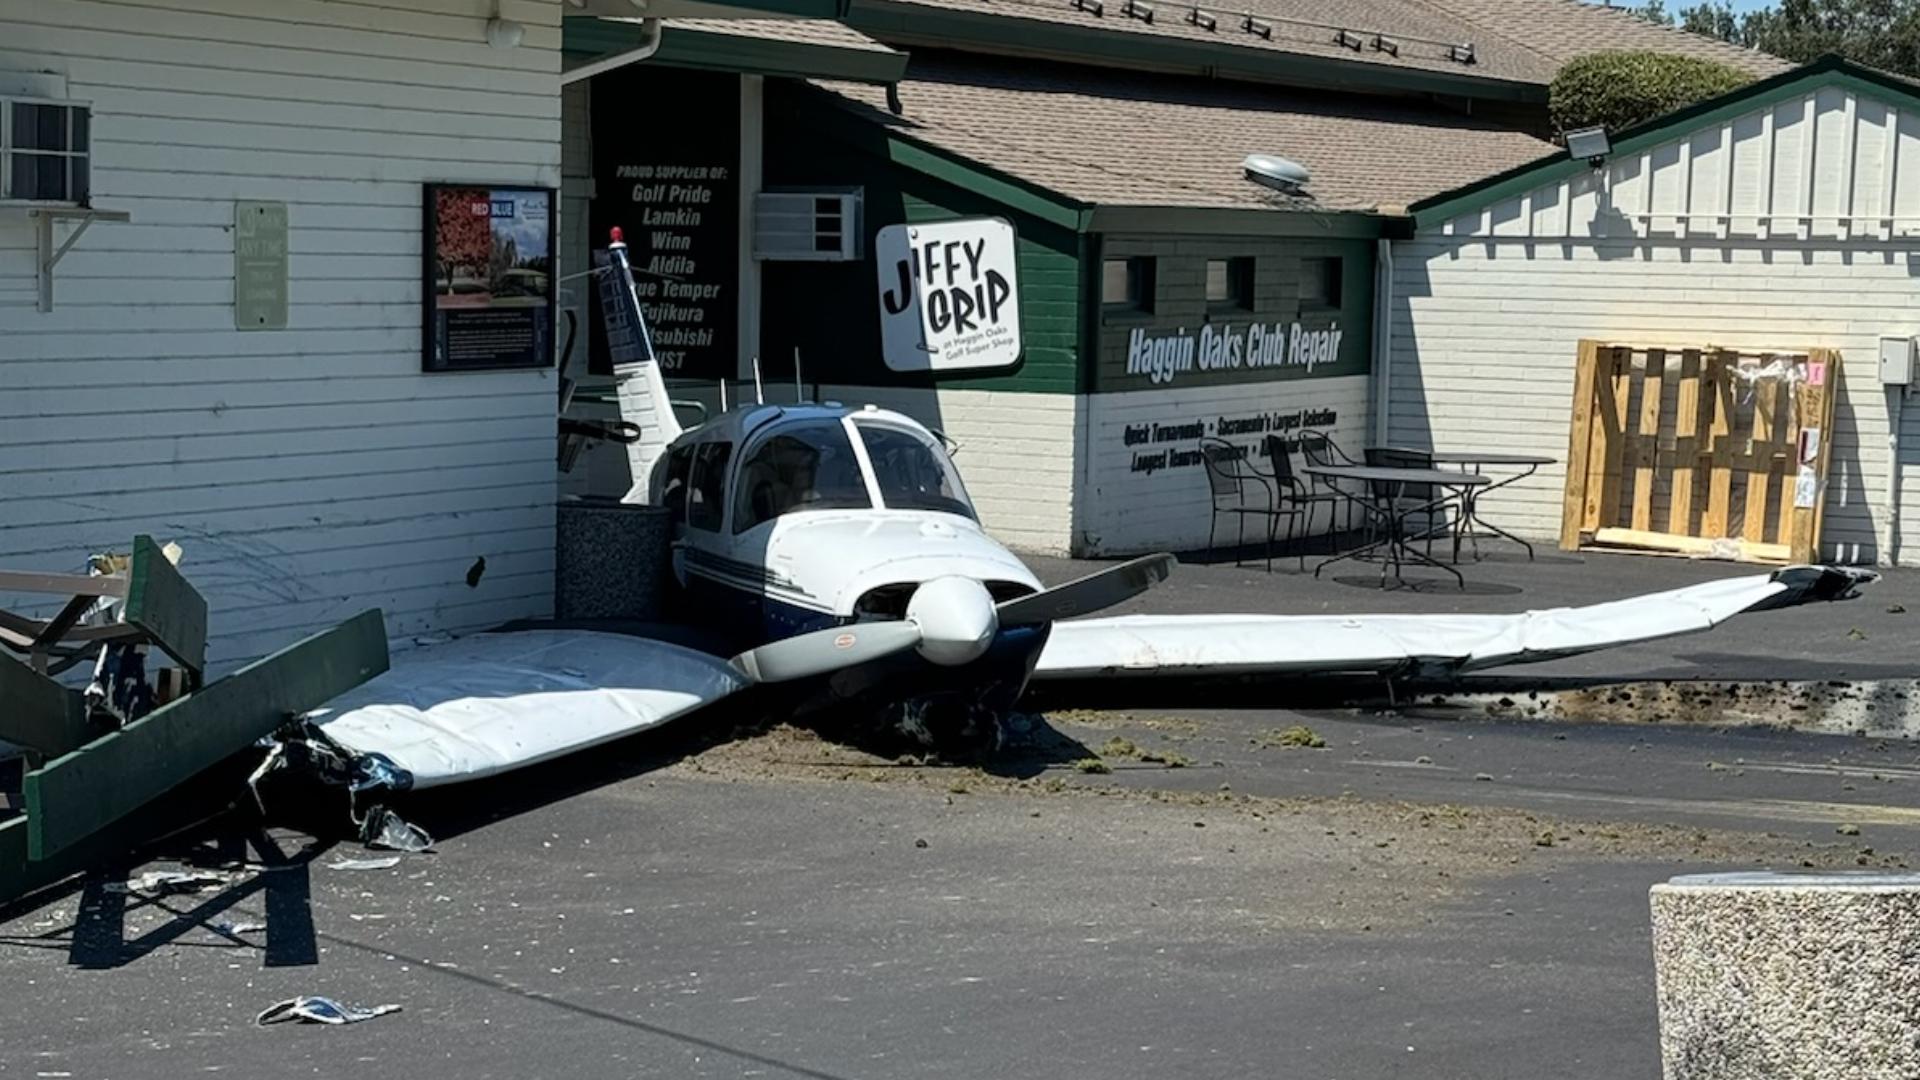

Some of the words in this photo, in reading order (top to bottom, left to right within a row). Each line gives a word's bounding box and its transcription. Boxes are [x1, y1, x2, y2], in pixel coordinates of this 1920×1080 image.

[616, 165, 654, 178] PROUD
[655, 165, 708, 179] SUPPLIER
[709, 167, 728, 179] OF:
[632, 183, 666, 202] Golf
[668, 184, 712, 203] Pride
[471, 203, 489, 216] RED
[491, 202, 513, 216] BLUE
[642, 207, 701, 226] Lamkin
[651, 231, 691, 250] Winn
[648, 255, 696, 274] Aldila
[662, 279, 721, 302] Temper
[927, 268, 1010, 335] GRIP
[650, 326, 714, 346] tsubishi
[953, 333, 984, 347] Haggin
[985, 325, 1008, 338] Oaks
[946, 347, 964, 360] Golf
[965, 343, 990, 356] Super
[991, 336, 1014, 349] Shop
[1126, 327, 1195, 384] Haggin
[1198, 324, 1242, 371] Oaks
[1246, 322, 1285, 368] Club
[1287, 321, 1343, 374] Repair
[1125, 423, 1150, 447] Quick
